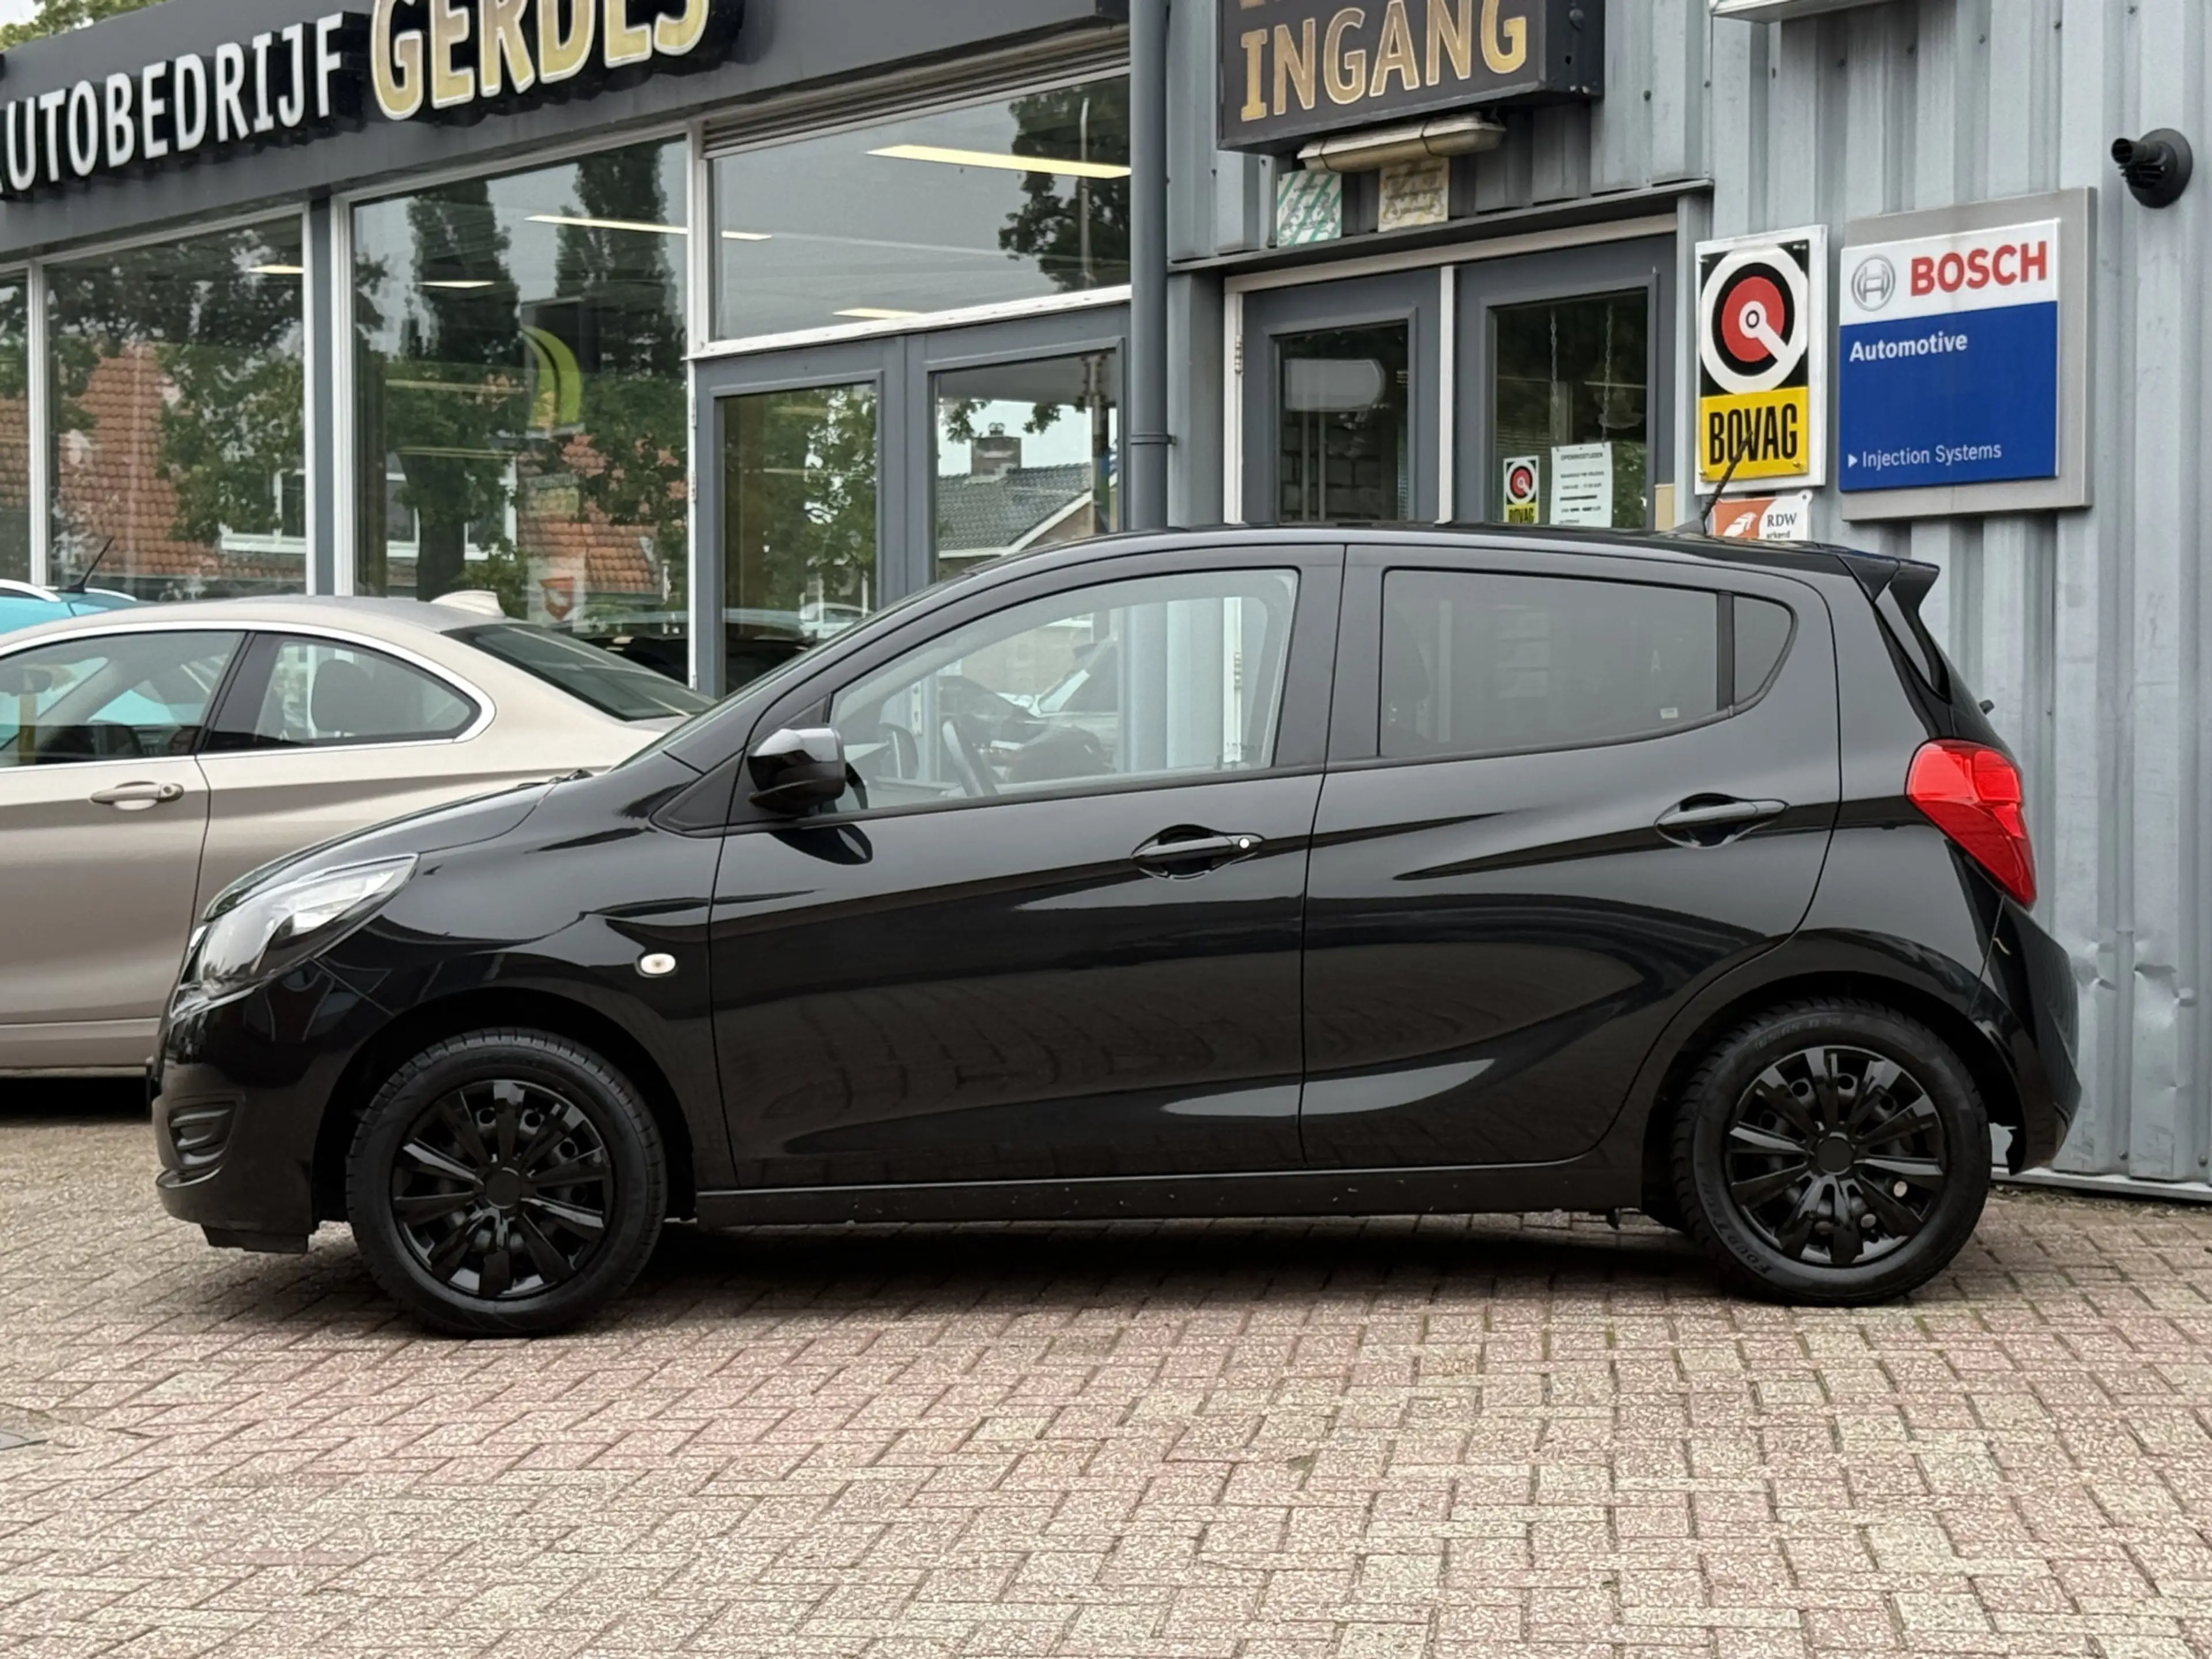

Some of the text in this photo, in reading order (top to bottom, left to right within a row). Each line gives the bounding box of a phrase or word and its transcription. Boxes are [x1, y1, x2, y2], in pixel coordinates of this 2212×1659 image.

[1240, 0, 1527, 122] INGANG
[0, 12, 344, 194] UTOBEDRIJF
[1910, 240, 2048, 297] BOSCH
[1849, 331, 1968, 362] Automotive
[1709, 403, 1798, 466] BOVAG
[1862, 444, 2002, 471] Injection Systems
[1767, 512, 1798, 528] RDW
